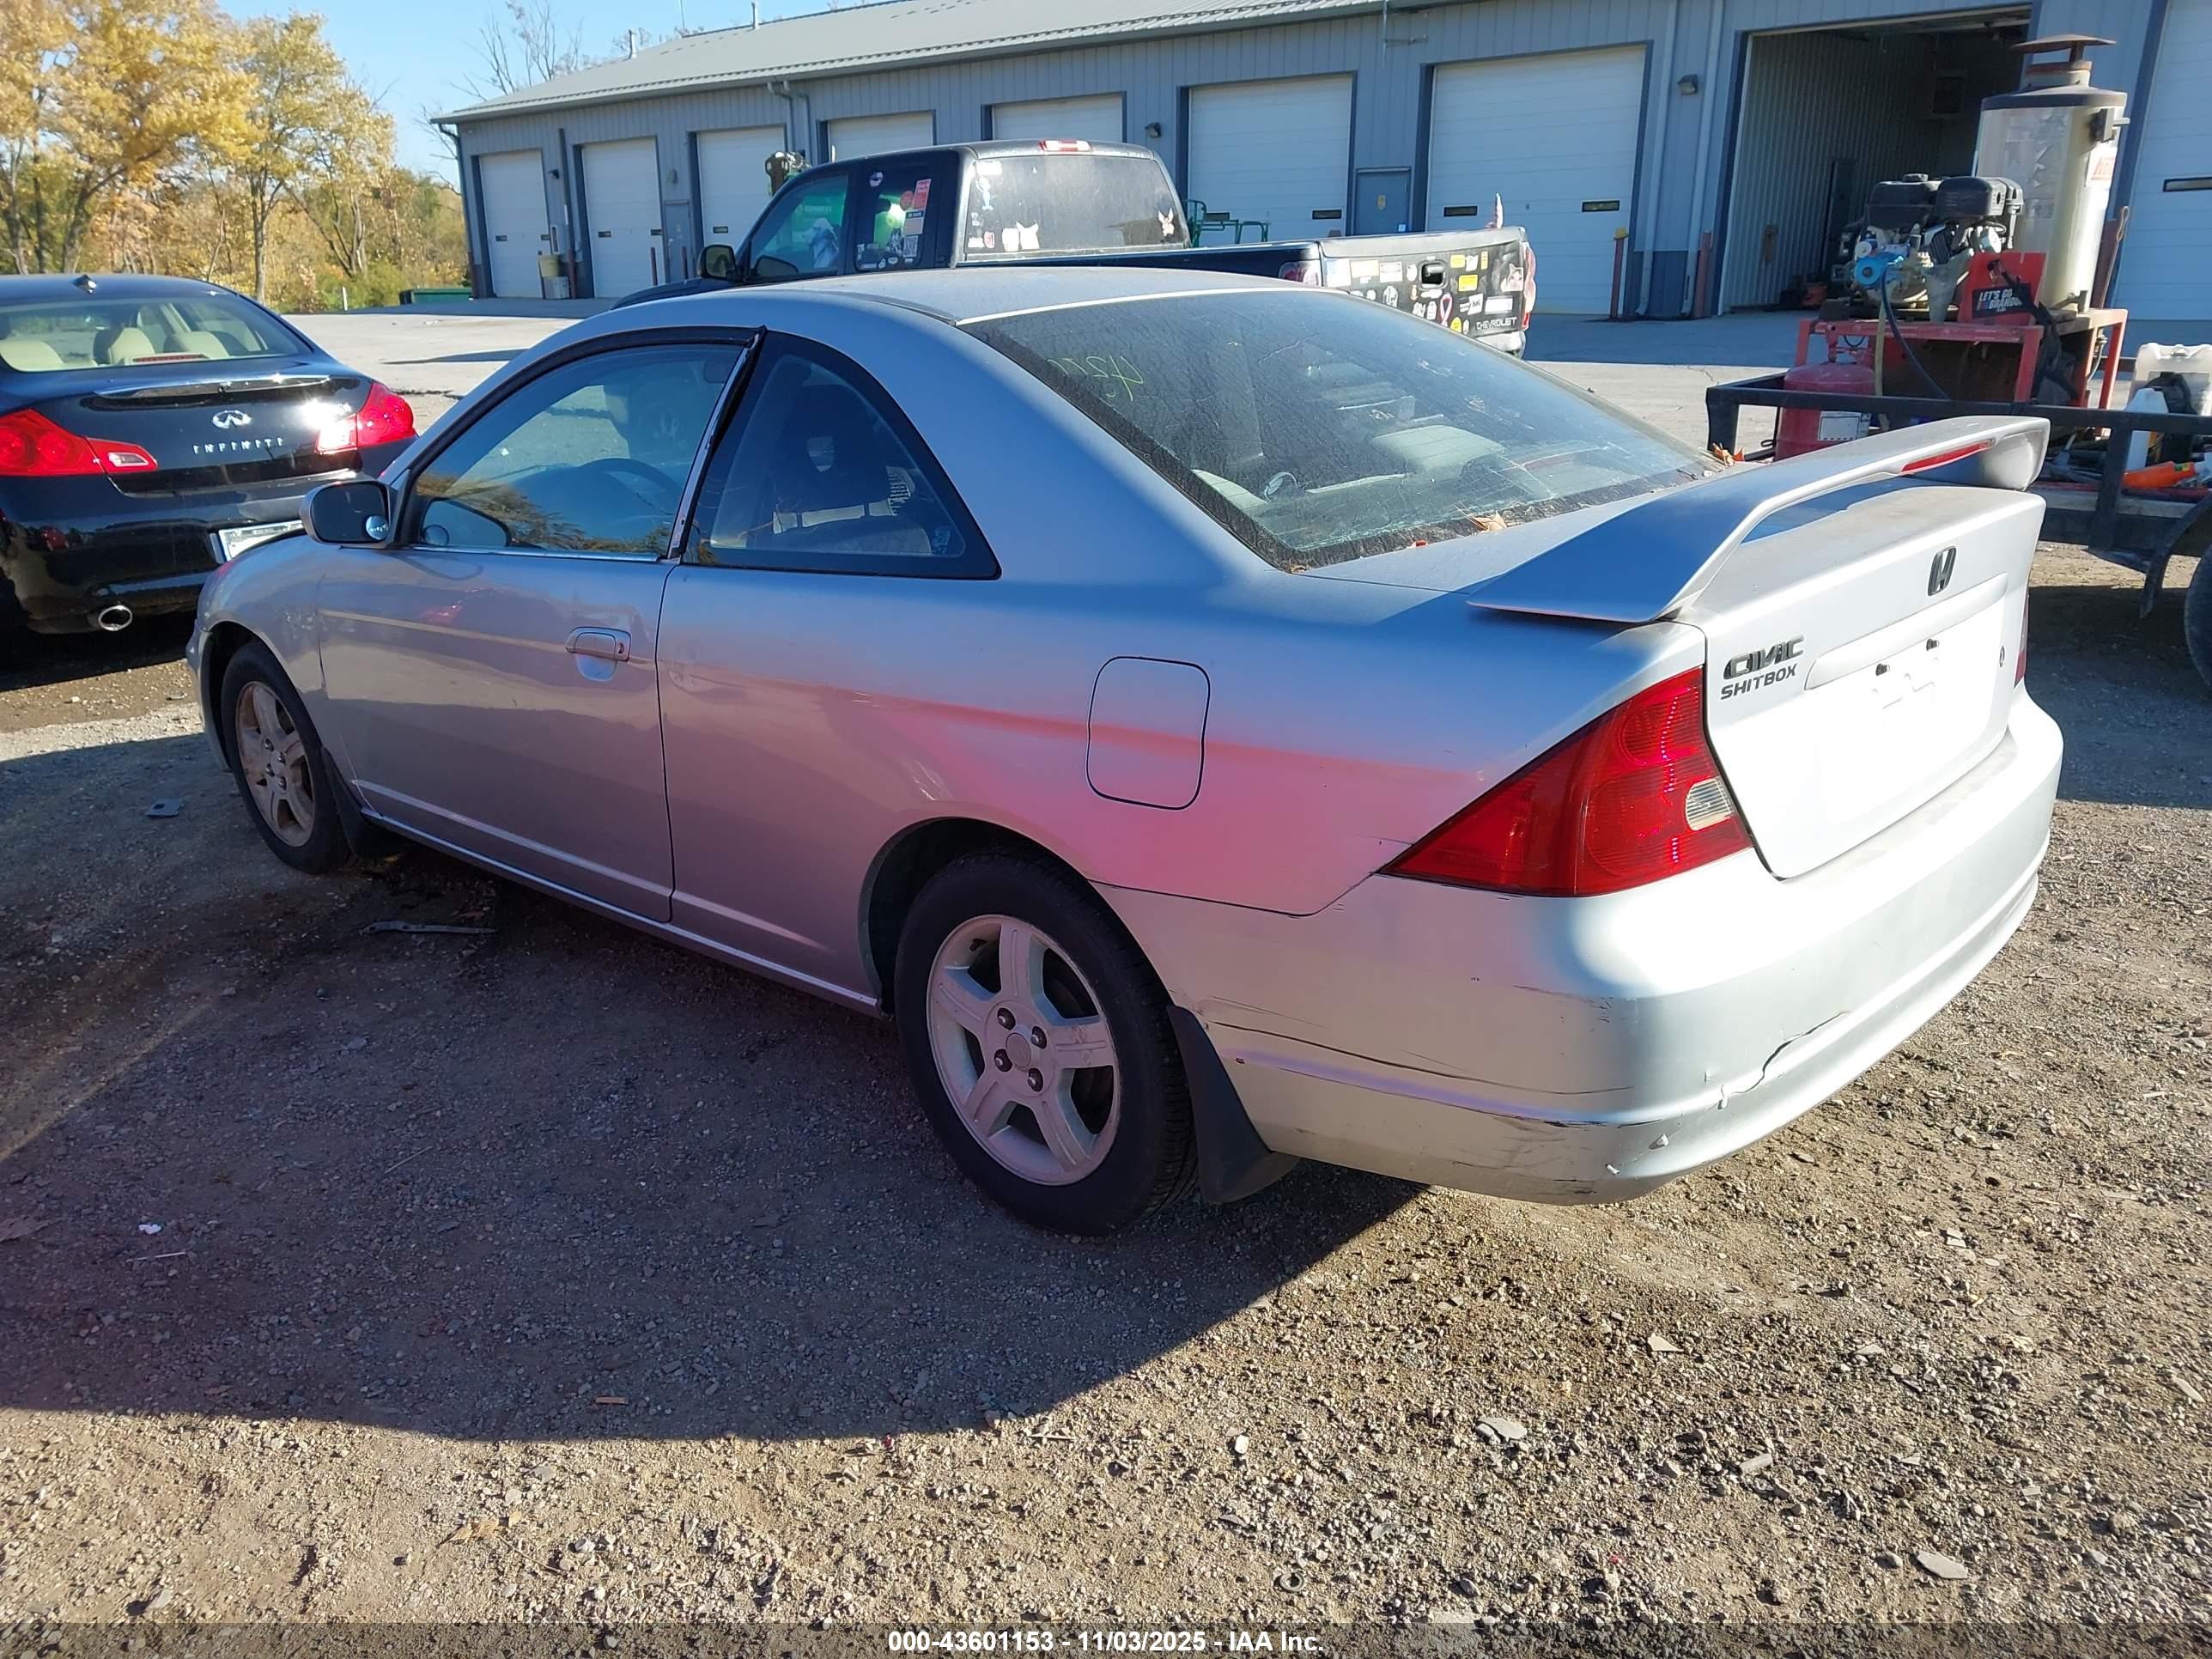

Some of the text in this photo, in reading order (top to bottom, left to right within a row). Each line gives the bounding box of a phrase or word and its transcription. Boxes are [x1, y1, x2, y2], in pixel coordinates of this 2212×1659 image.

[1979, 290, 2001, 301] LET'S
[1476, 316, 1517, 331] CHEVROLET
[192, 437, 284, 454] INFINITI
[1723, 635, 1804, 679] CIVIC
[1720, 663, 1798, 701] SHITBOX
